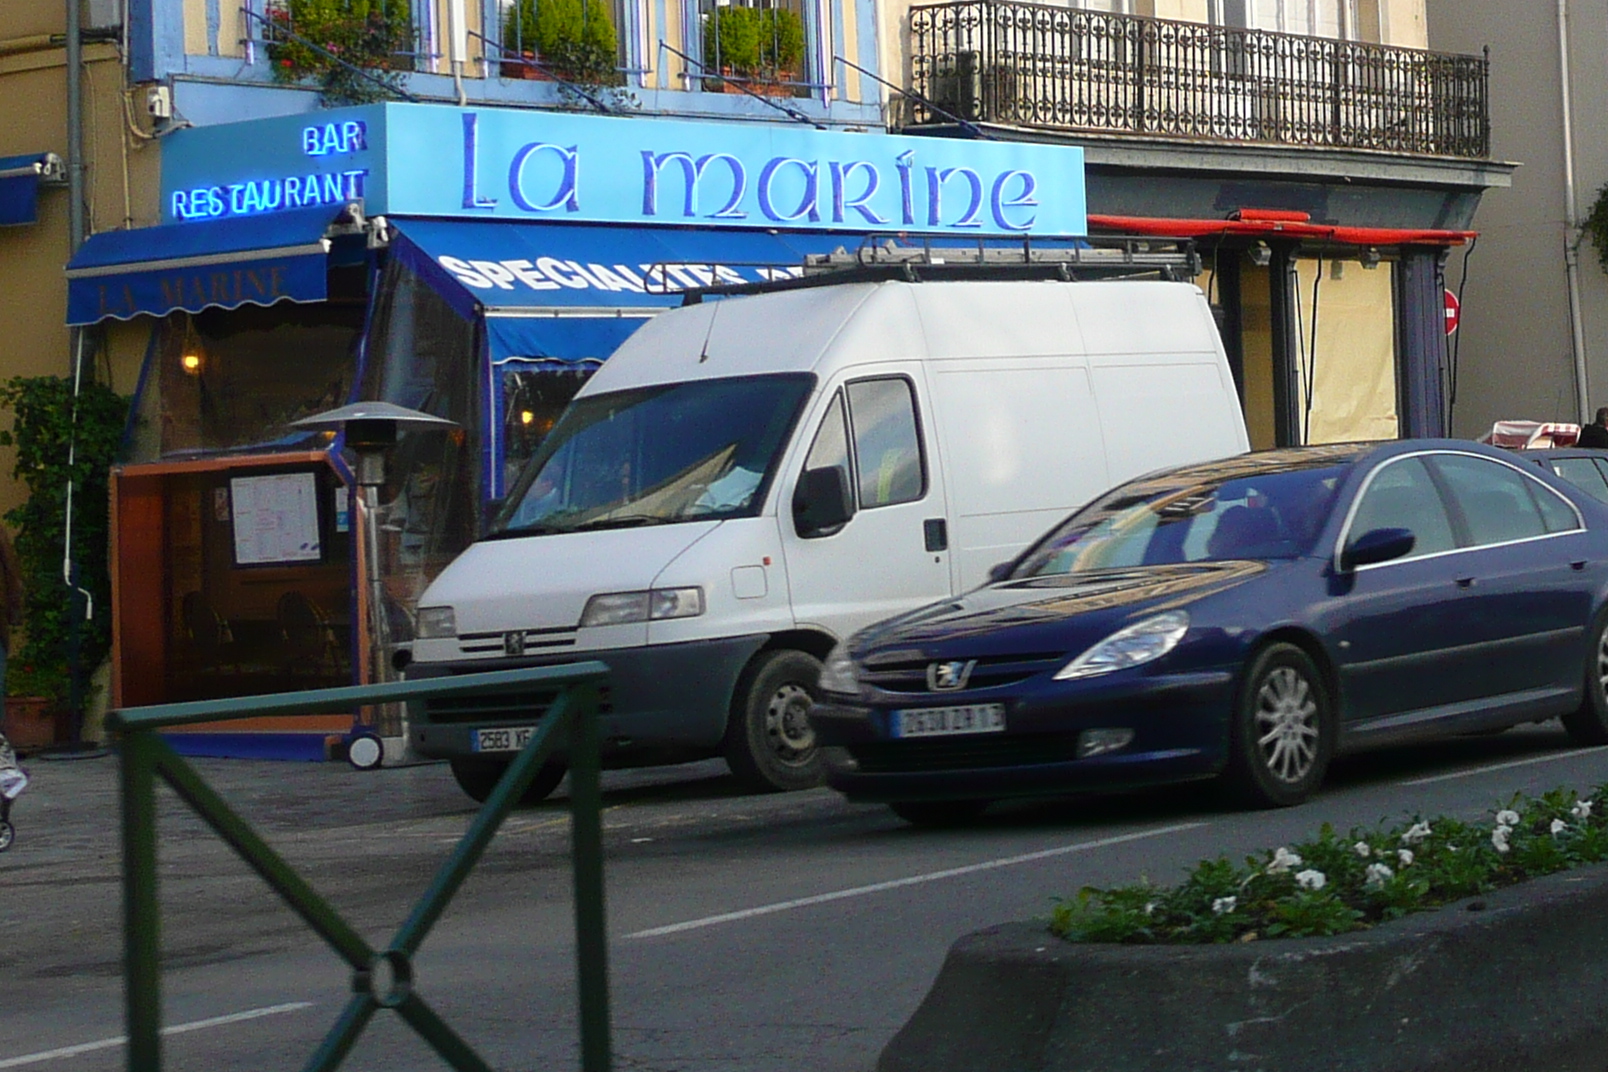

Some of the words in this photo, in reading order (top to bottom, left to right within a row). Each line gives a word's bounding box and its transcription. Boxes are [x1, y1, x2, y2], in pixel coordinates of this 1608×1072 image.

[303, 121, 367, 156] BAR
[461, 112, 580, 213] La
[172, 171, 368, 220] RESTAURANT
